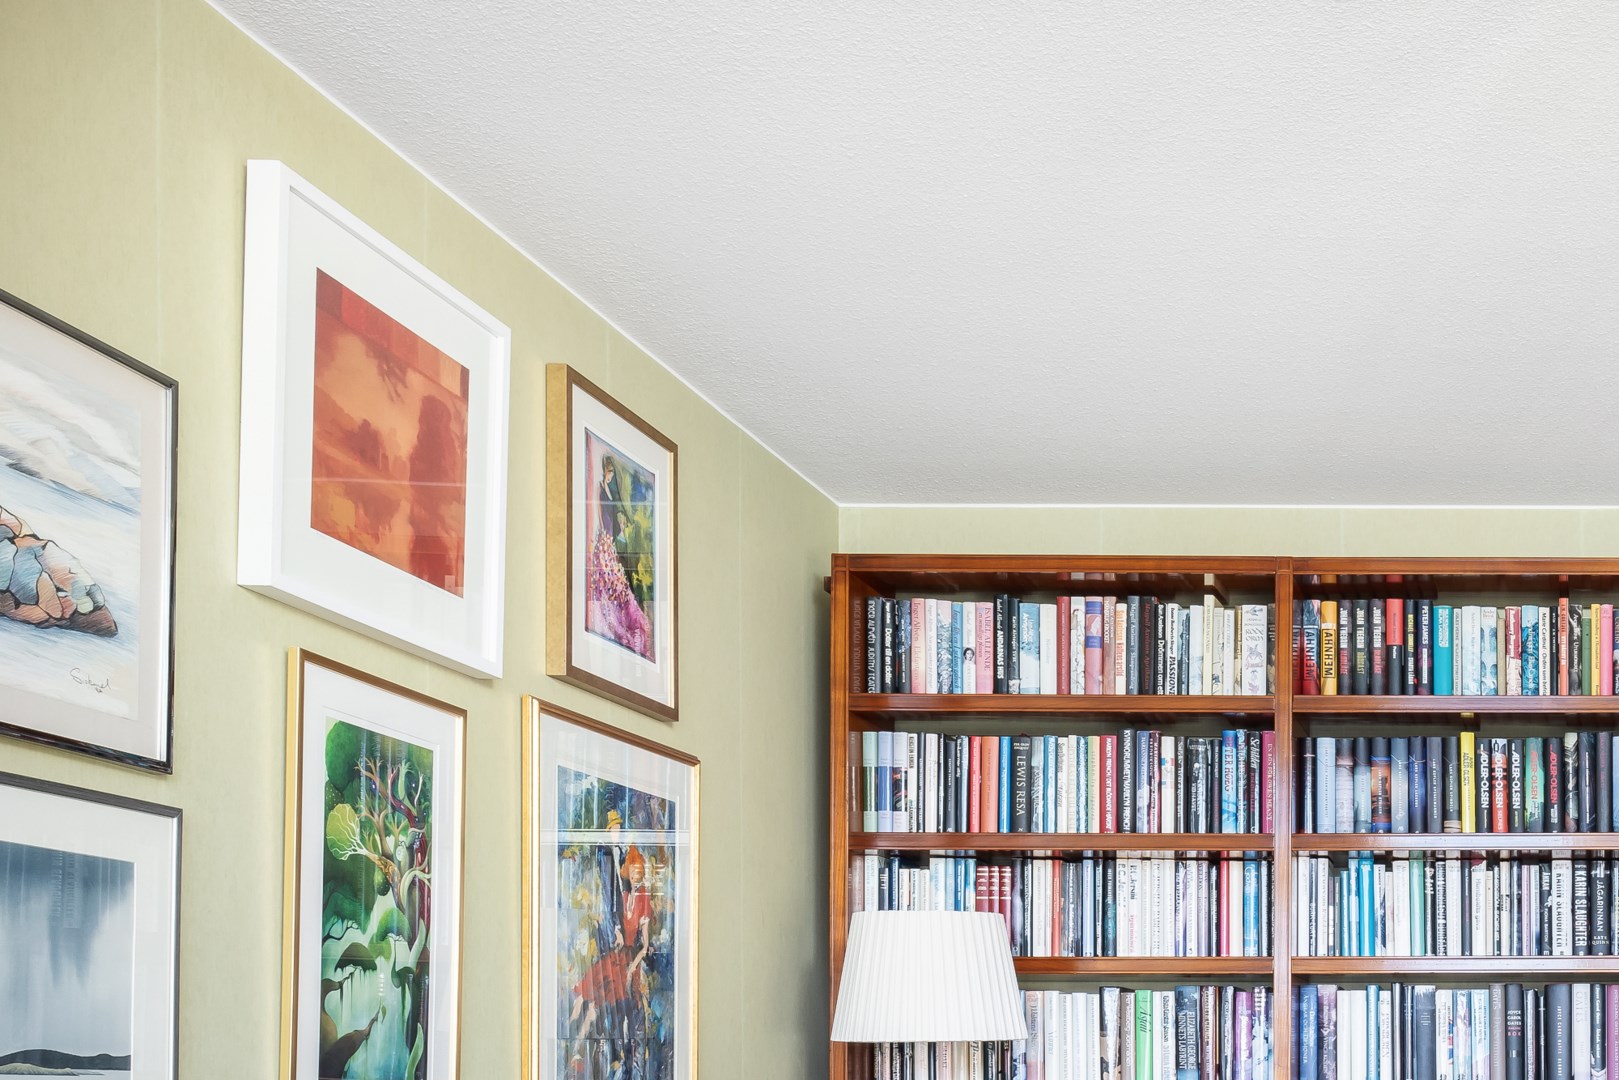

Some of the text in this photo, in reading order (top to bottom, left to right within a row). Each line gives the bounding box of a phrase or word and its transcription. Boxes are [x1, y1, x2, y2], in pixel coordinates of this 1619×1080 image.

[867, 600, 876, 619] INGER
[1340, 607, 1348, 624] JOHAN
[1356, 607, 1364, 649] JOHAN THEORIN
[1373, 607, 1381, 625] JOHAN
[1421, 605, 1429, 645] PETER JAMES
[884, 628, 893, 685] Dotter till en dotter
[984, 607, 992, 672] ISABEL ALLENDE
[996, 630, 1004, 679] ANDARNAS HUS
[1340, 627, 1348, 649] THEORIN
[1373, 626, 1381, 648] THEORIN
[1156, 640, 1164, 685] Drömmen om
[1224, 736, 1233, 768] PETER
[1530, 751, 1539, 800] ADLER-OLSEN
[1016, 755, 1026, 817] LEWIS RESA
[1480, 752, 1489, 809] ADLER-OLSEN
[1495, 752, 1504, 808] ADLER-OLSEN
[1512, 751, 1520, 809] ADLER-OLSEN
[1549, 751, 1557, 804] ADLER-OLSEN
[1122, 807, 1131, 831] FRENCH
[1541, 872, 1551, 891] ÄNKAN
[1574, 871, 1587, 948] KARIN SLAUGHTER
[1596, 880, 1605, 933] JÄGARINNAN
[1178, 1011, 1187, 1070] MINNETS LABYRINT
[1186, 1011, 1196, 1070] ELIZABETH GEORGE
